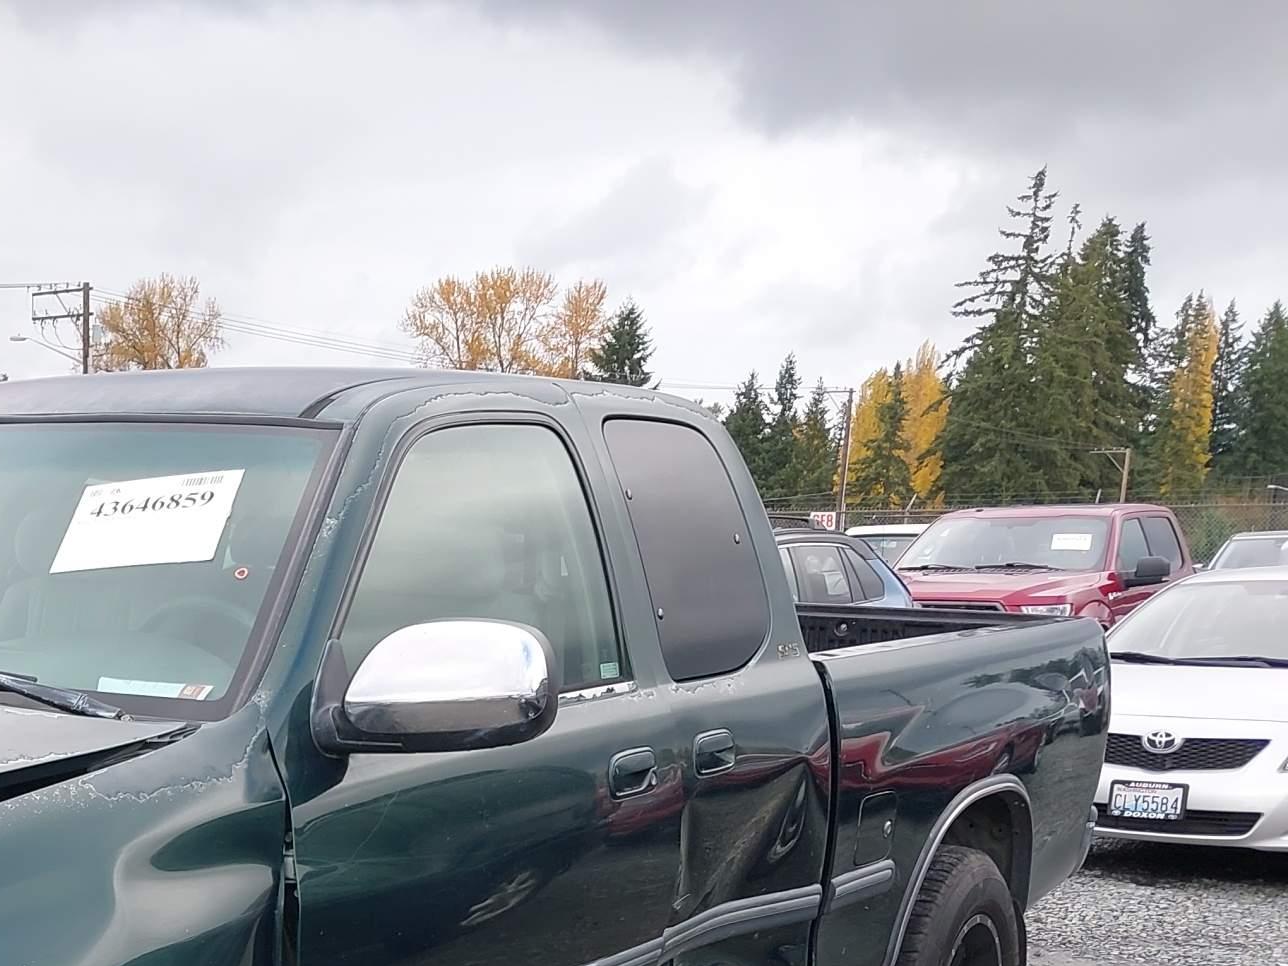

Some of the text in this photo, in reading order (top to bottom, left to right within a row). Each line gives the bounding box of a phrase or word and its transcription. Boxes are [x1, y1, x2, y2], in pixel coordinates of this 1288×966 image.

[90, 490, 215, 518] 43646859
[1129, 781, 1169, 789] AUBURN
[1113, 793, 1179, 815] CLY5584
[1123, 811, 1165, 820] DOXON
